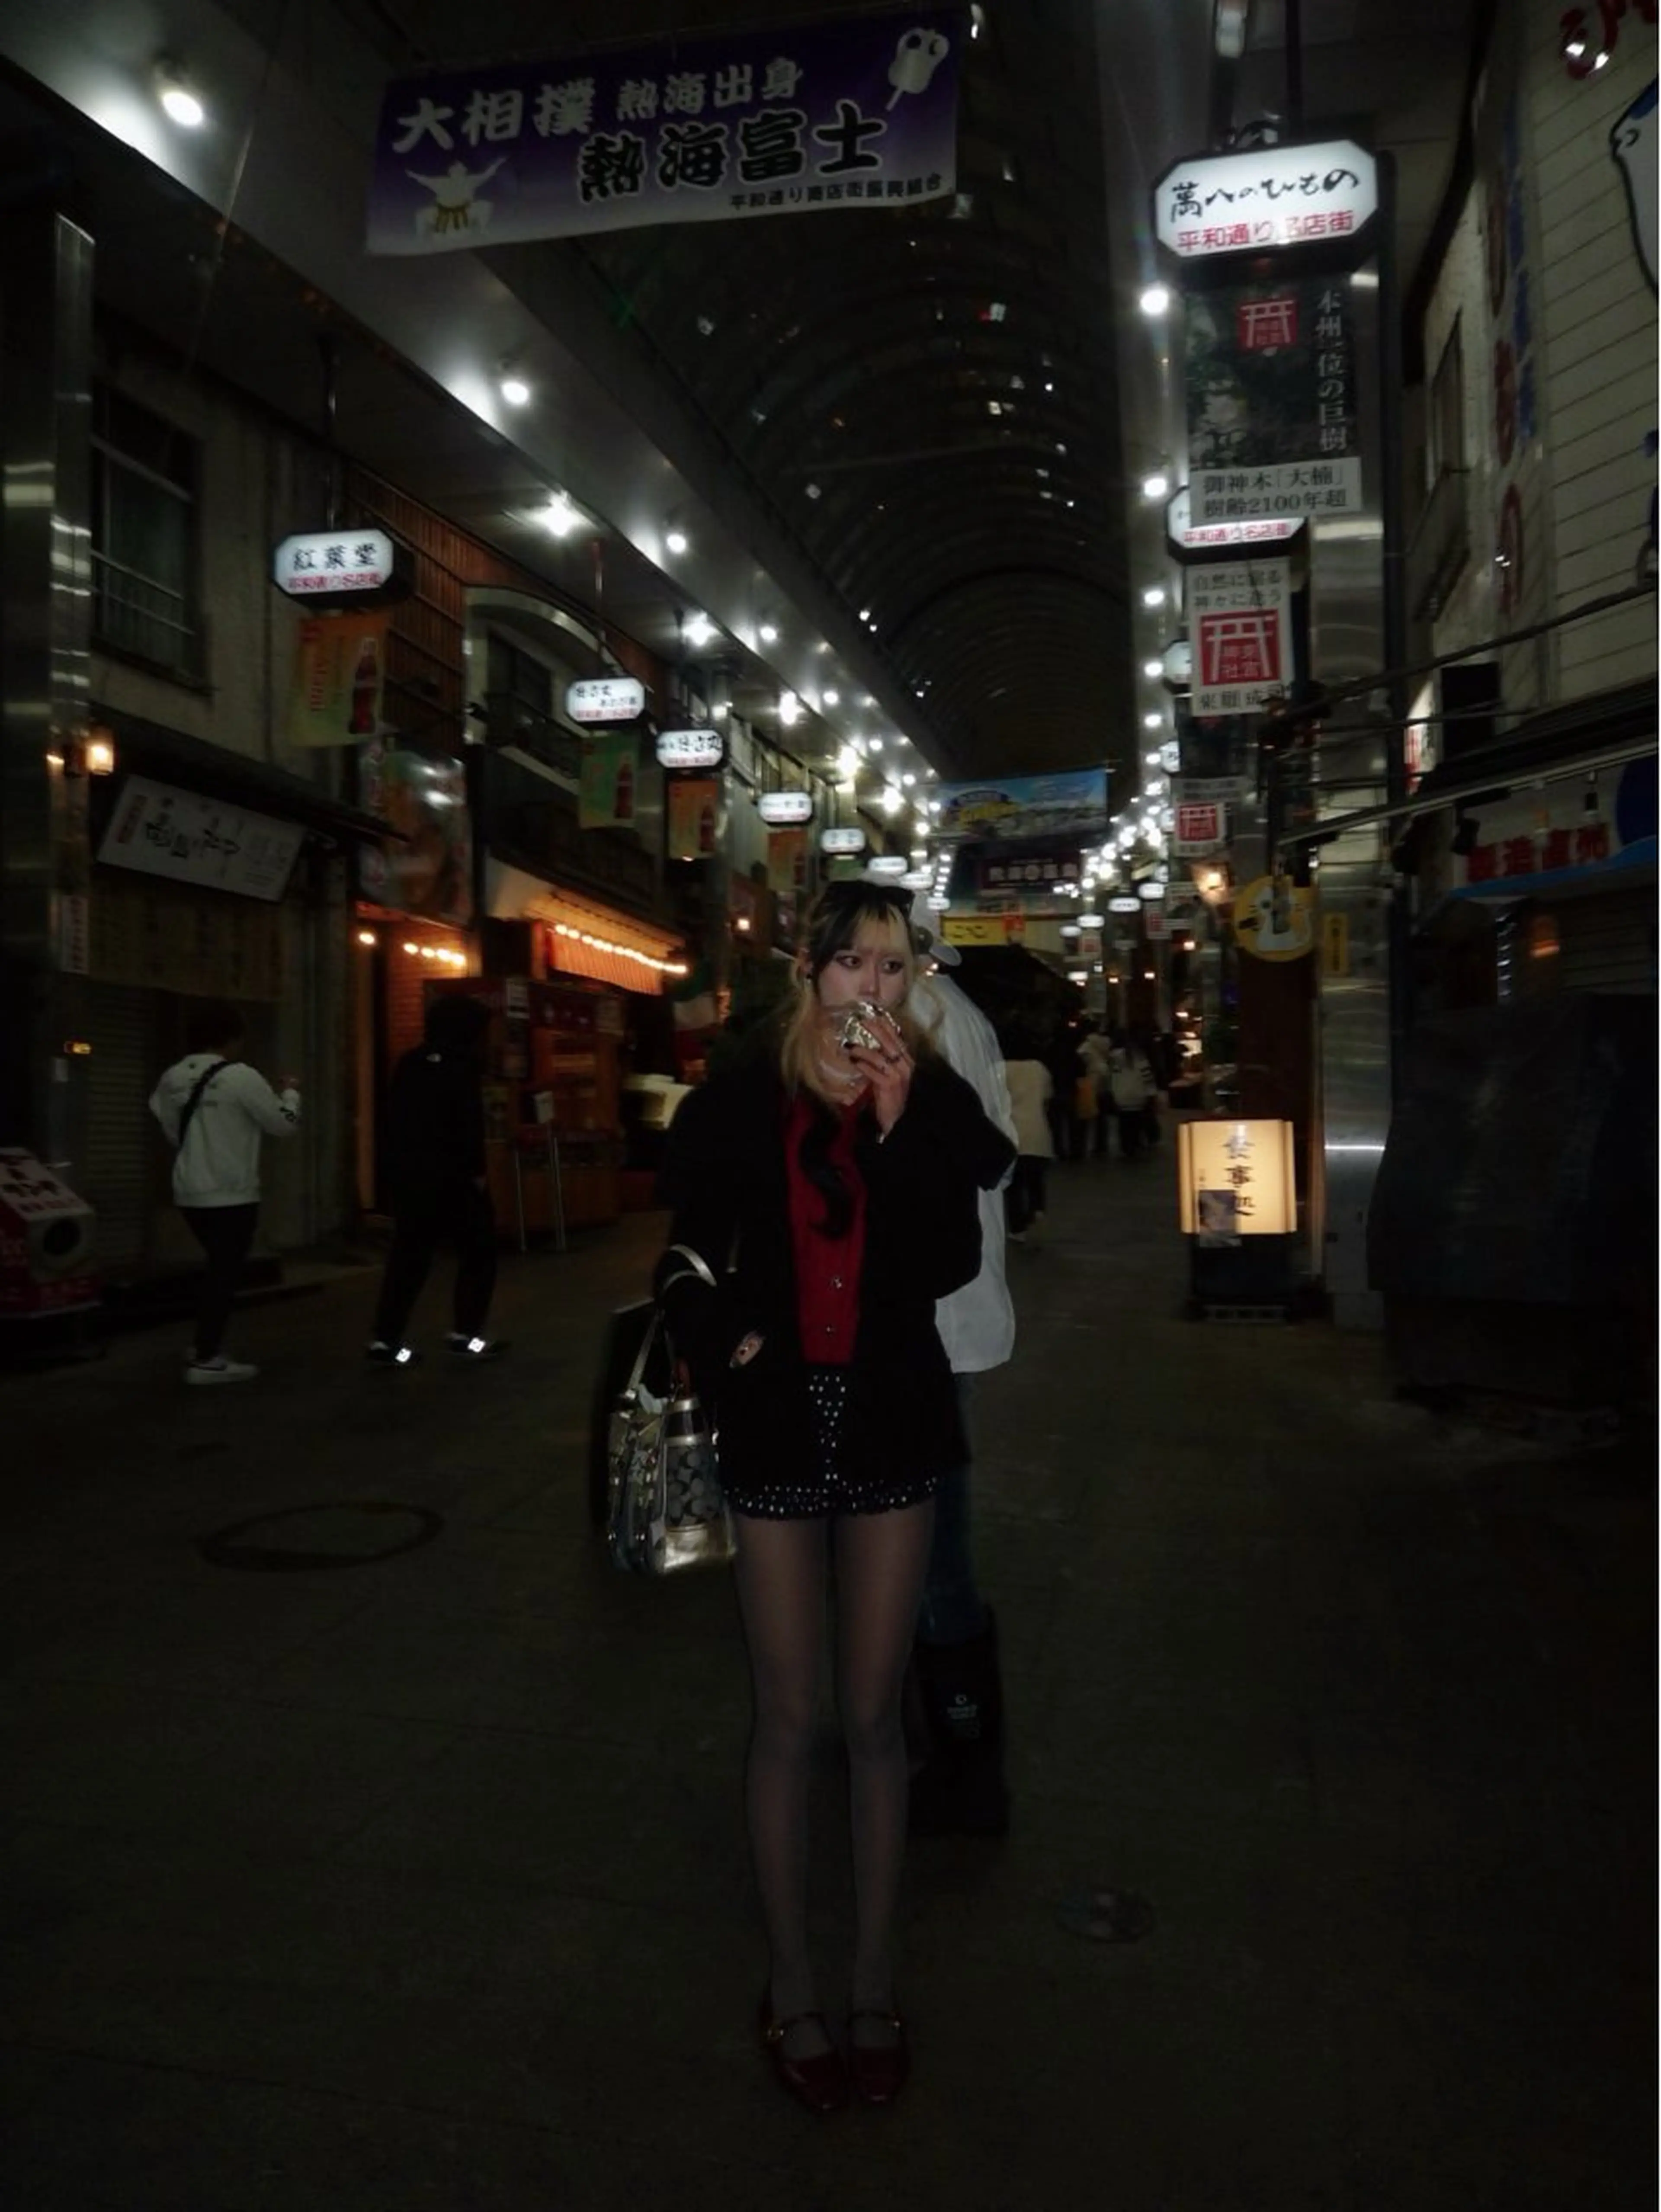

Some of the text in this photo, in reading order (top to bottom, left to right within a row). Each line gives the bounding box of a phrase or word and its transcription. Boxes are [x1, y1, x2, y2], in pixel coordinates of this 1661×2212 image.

[392, 56, 804, 154] 大相撲 熱海出身
[577, 99, 888, 203] 熱海富士
[1315, 289, 1347, 451] 本州一位の巨樹
[1204, 489, 1347, 518] 樹齢2100年超
